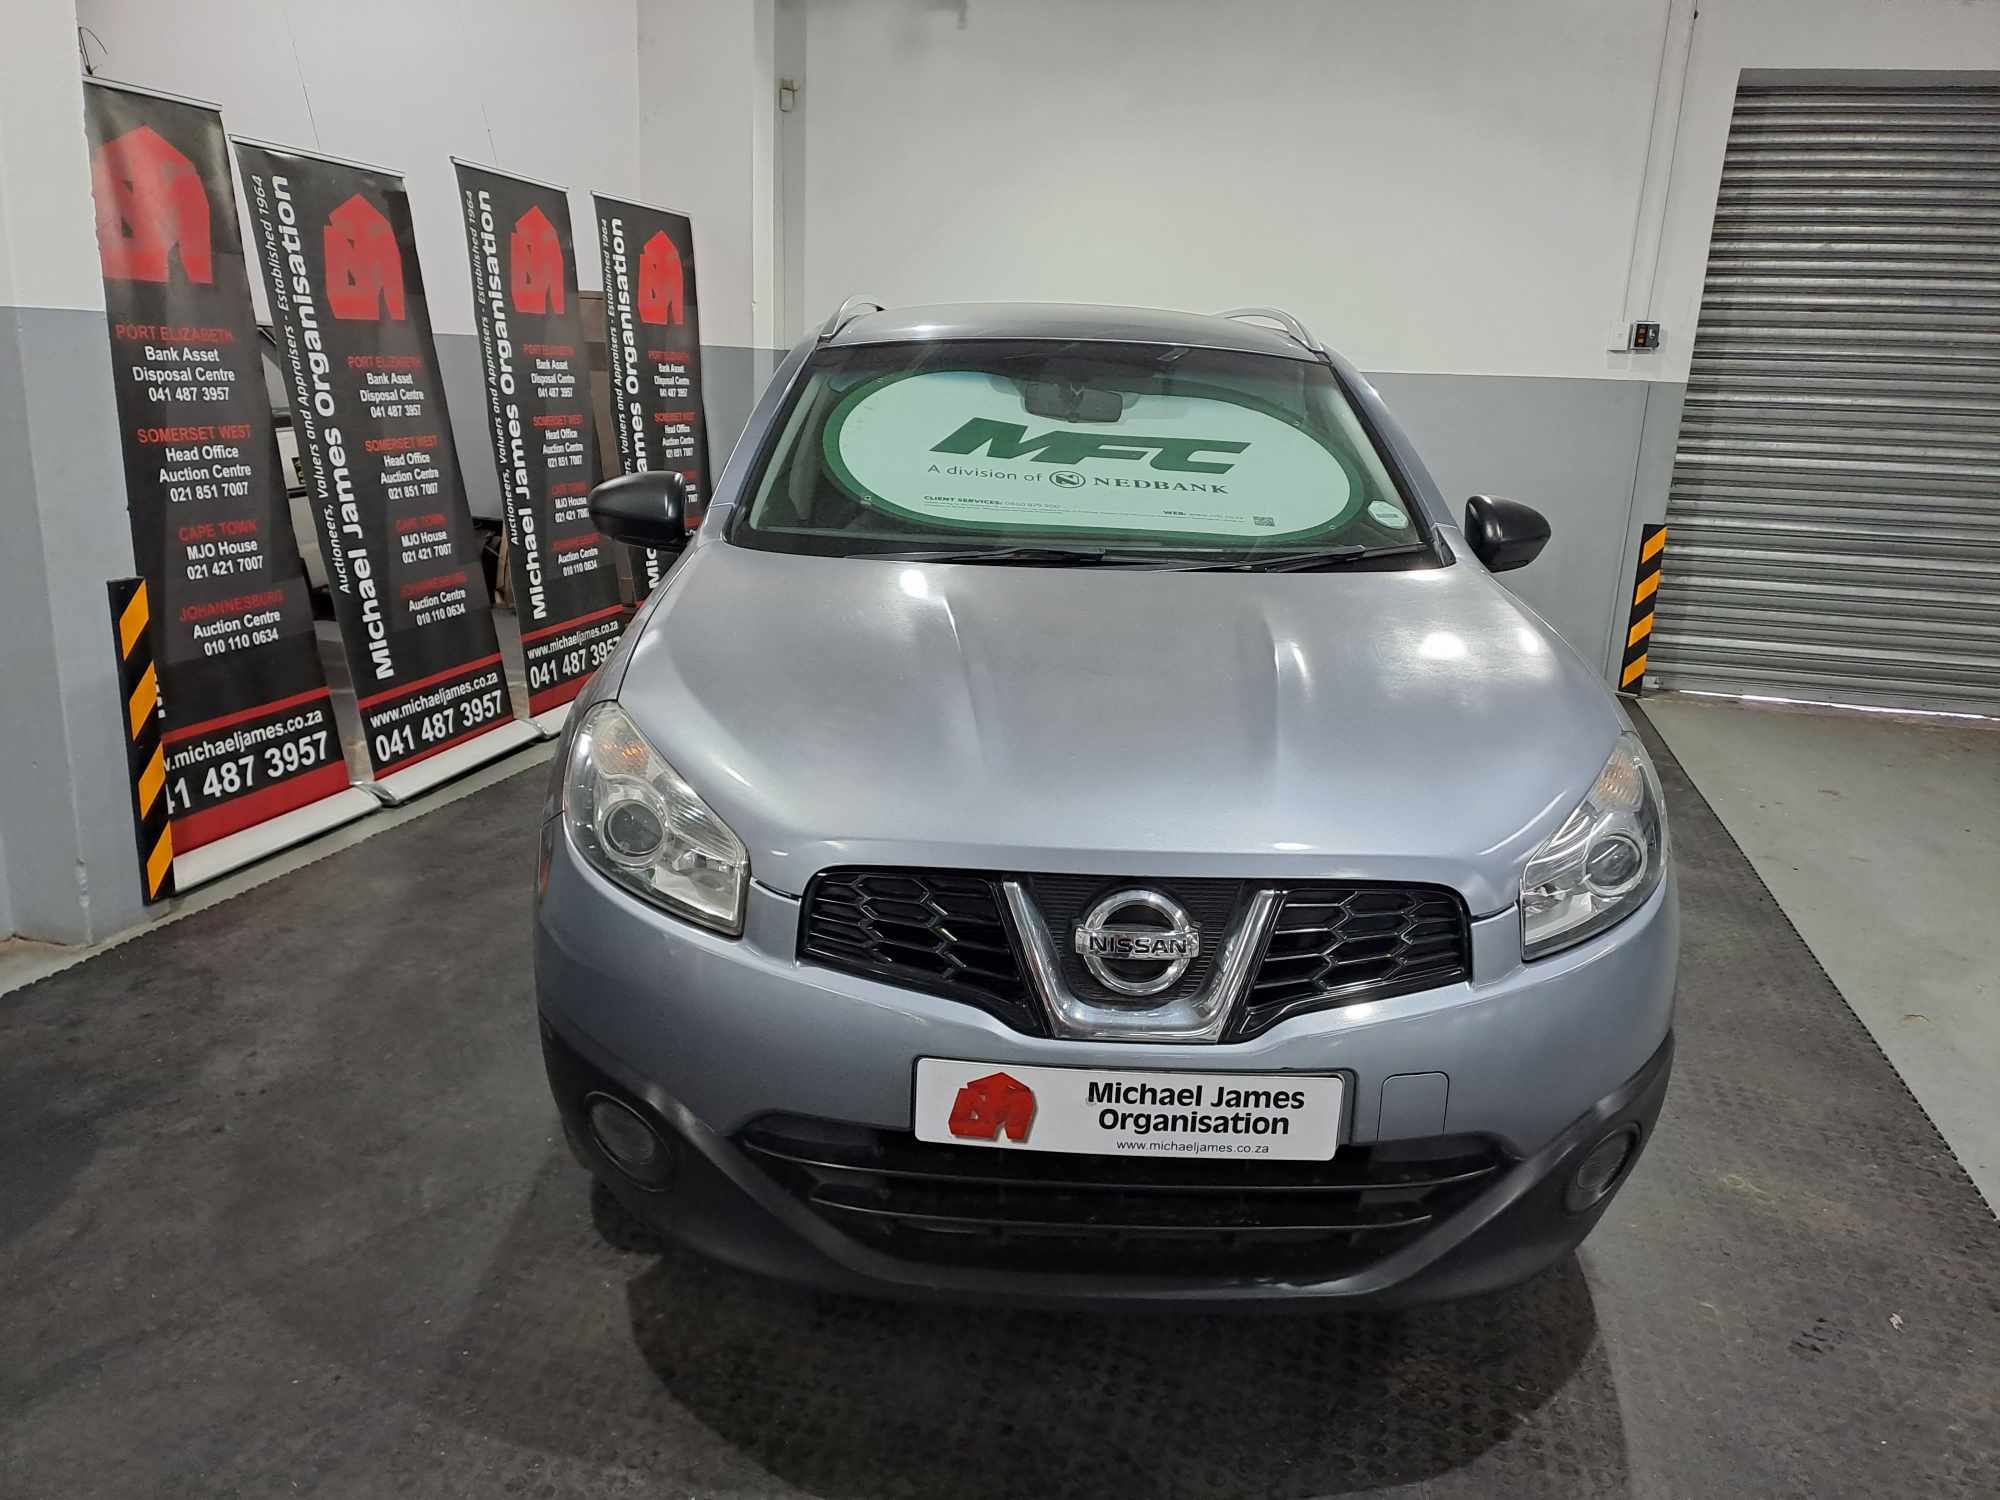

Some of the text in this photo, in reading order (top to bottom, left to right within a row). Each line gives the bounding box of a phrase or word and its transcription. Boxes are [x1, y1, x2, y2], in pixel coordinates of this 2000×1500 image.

[252, 174, 269, 215] 1964
[465, 190, 476, 224] 1964
[260, 218, 290, 310] Established
[470, 227, 486, 304] Established
[115, 324, 157, 340] PORT
[611, 218, 648, 473] ames Organisation
[144, 345, 220, 362] Bank Asset
[480, 316, 496, 385] Appraisers
[608, 326, 624, 386] Appraisers
[132, 366, 236, 385] Disposal Centre
[285, 325, 310, 407] Appraisers
[366, 372, 414, 385] Bank Asset
[148, 387, 230, 402] 041 487 3957
[360, 388, 425, 404] Disposal Centre
[478, 190, 548, 620] Michael James Organisation
[489, 388, 501, 413] and
[614, 389, 625, 411] and
[299, 409, 316, 440] and
[370, 406, 386, 418] 041
[387, 405, 403, 417] 487
[137, 424, 252, 444] SOMERSET WEST
[271, 175, 395, 680] Michael James Organisation
[494, 416, 508, 464] Valuers
[616, 412, 629, 454] Valuers
[165, 444, 240, 462] Head Office
[383, 451, 431, 467] Head Office
[928, 417, 1253, 475] MFC
[159, 463, 252, 483] Auction Centre
[310, 443, 329, 499] Valuers
[380, 467, 440, 484] Auction Centre
[927, 464, 1230, 494] A division of NEDBANK
[170, 481, 249, 502] 021 851 7007
[388, 486, 403, 500] 021
[404, 484, 420, 498] 851
[501, 469, 520, 545] Auctioneers,
[178, 523, 216, 541] CAPE
[401, 530, 448, 547] MJO House
[186, 540, 258, 560] MJO House
[323, 504, 352, 594] Auctioneers,
[402, 543, 452, 564] 021 421 7007
[187, 555, 264, 580] 021 421 7007
[408, 588, 467, 611] Auction Centre
[193, 610, 281, 640] Auction Centre
[416, 603, 466, 626] 010 110 0634
[204, 627, 279, 656] 010 110 0634
[527, 620, 619, 660] www.michaeljames.co.za
[530, 659, 558, 689] 041
[562, 648, 587, 676] 487
[370, 672, 499, 729] www.michaeljames.co.za
[375, 690, 502, 762] 041 487 3957
[202, 755, 255, 798] 487
[264, 730, 328, 778] 3957
[1089, 936, 1187, 953] NISSAN
[1088, 1081, 1305, 1110] Michael James
[1098, 1108, 1290, 1136] Organisation
[1116, 1140, 1270, 1154] www.michaeljames.co.za
